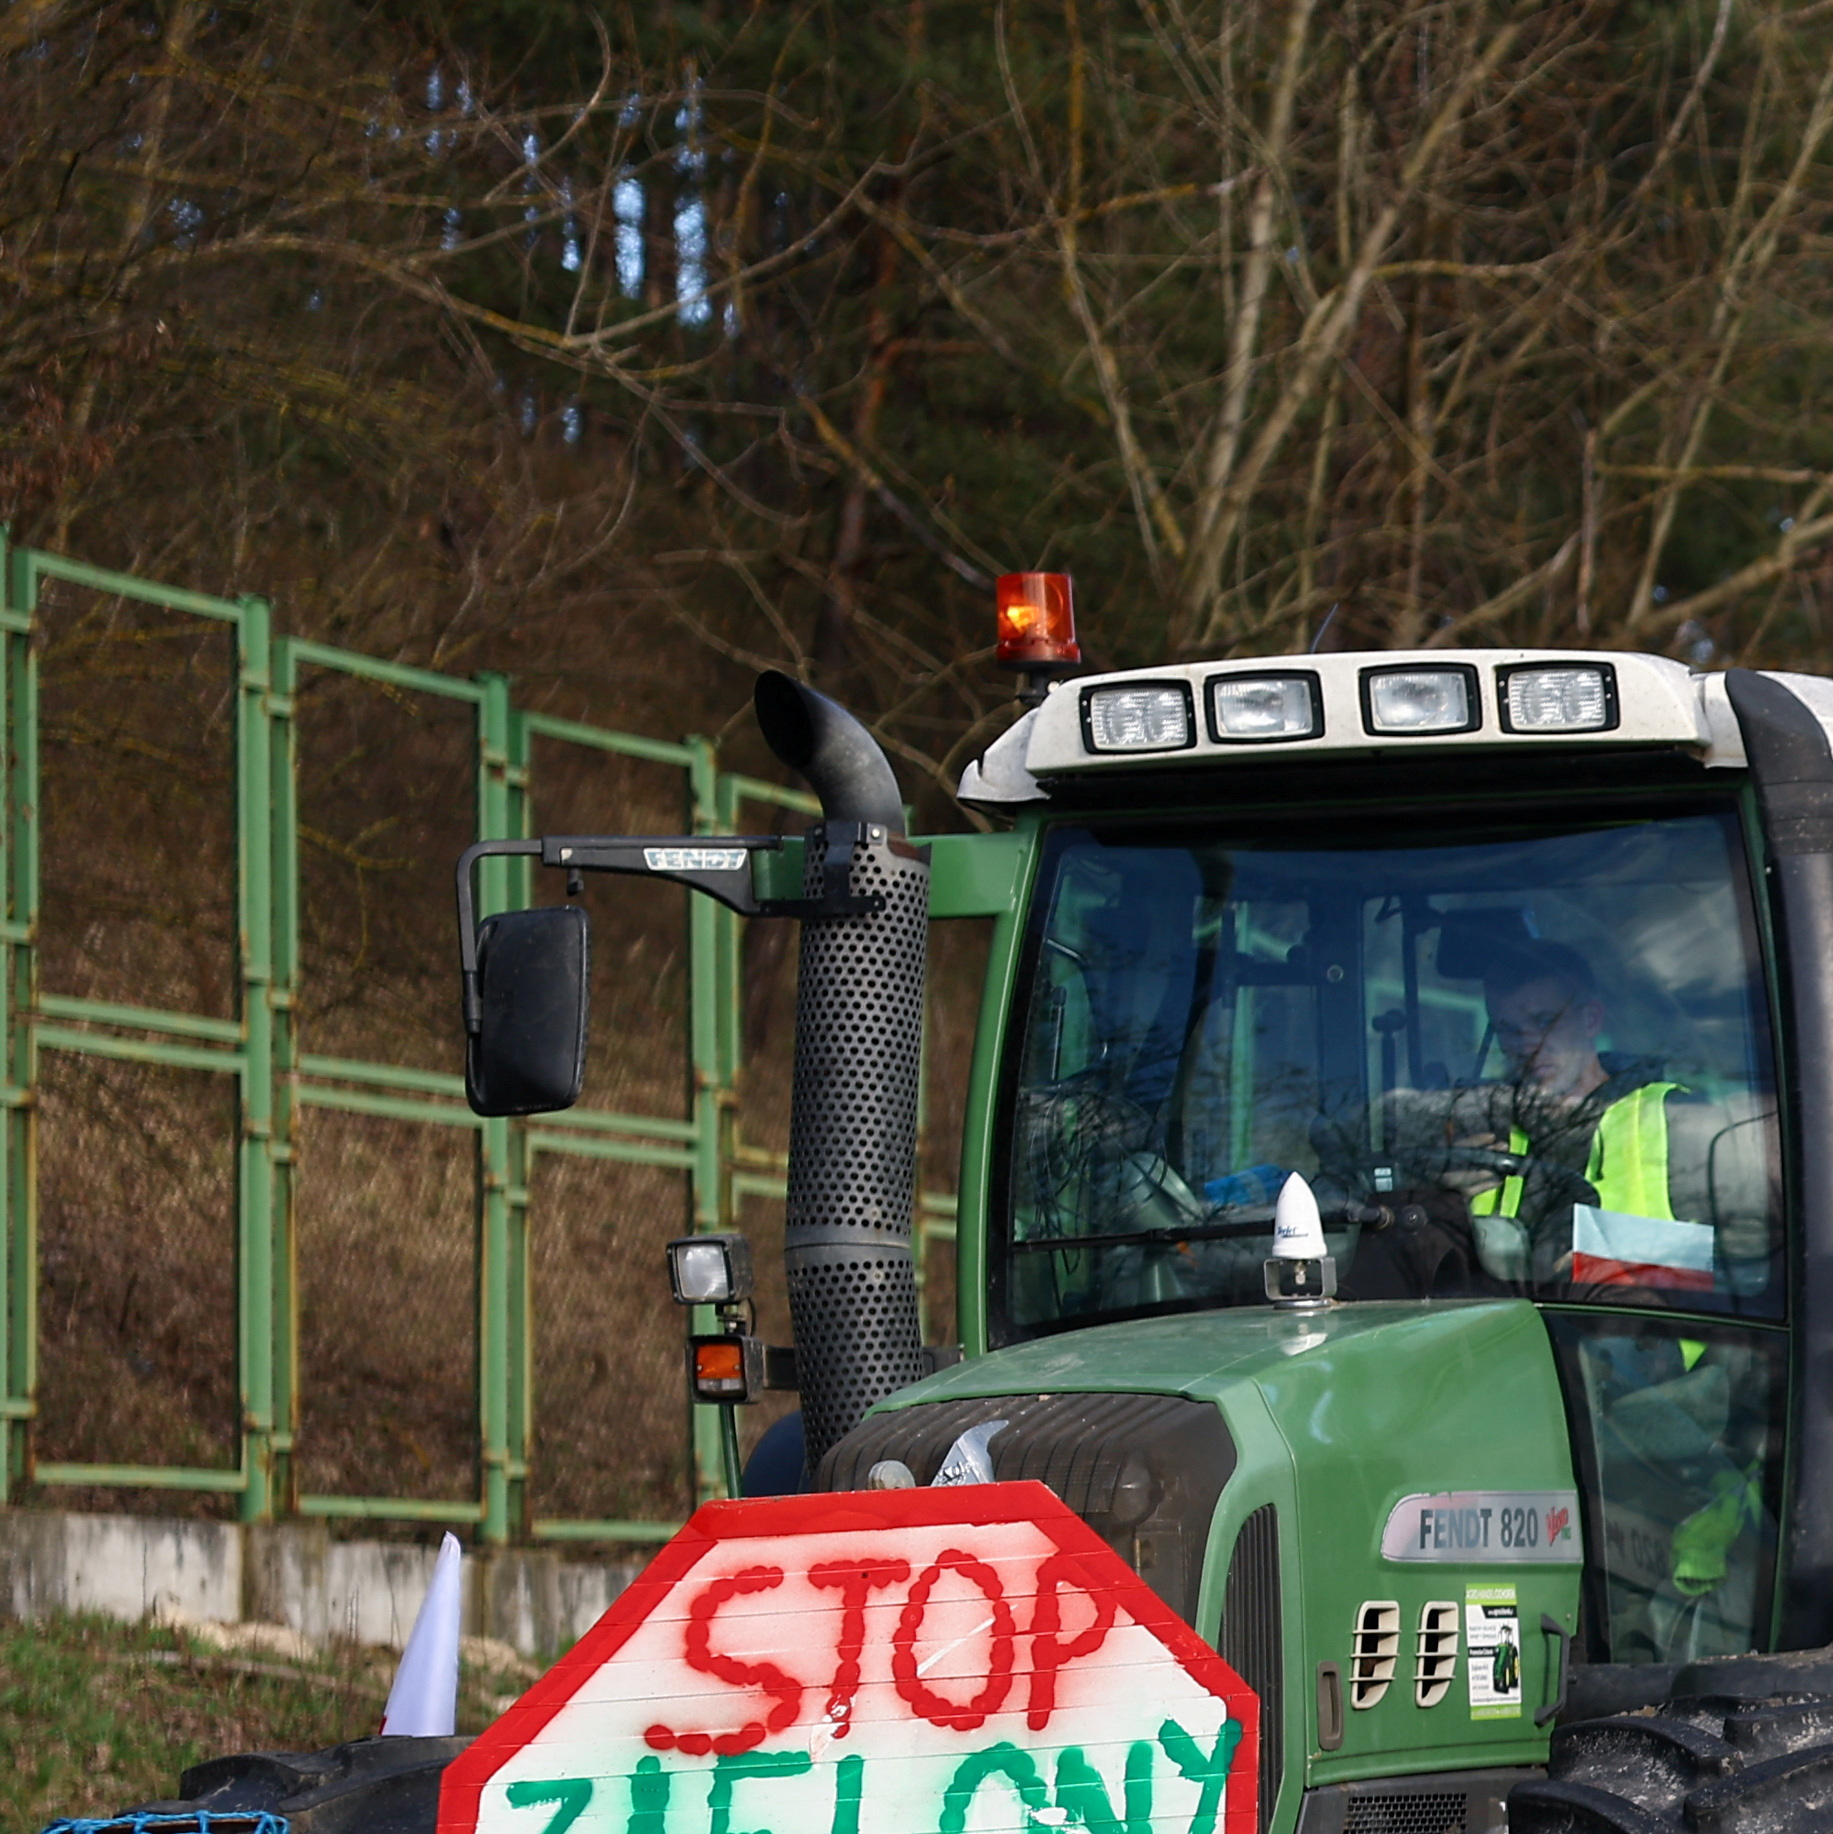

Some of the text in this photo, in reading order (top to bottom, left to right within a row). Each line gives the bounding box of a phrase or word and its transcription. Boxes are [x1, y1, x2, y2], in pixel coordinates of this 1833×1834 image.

[645, 850, 746, 868] FENDT
[1419, 1508, 1493, 1549] FENDT
[1500, 1507, 1539, 1548] 820
[645, 1548, 1115, 1756] STOP
